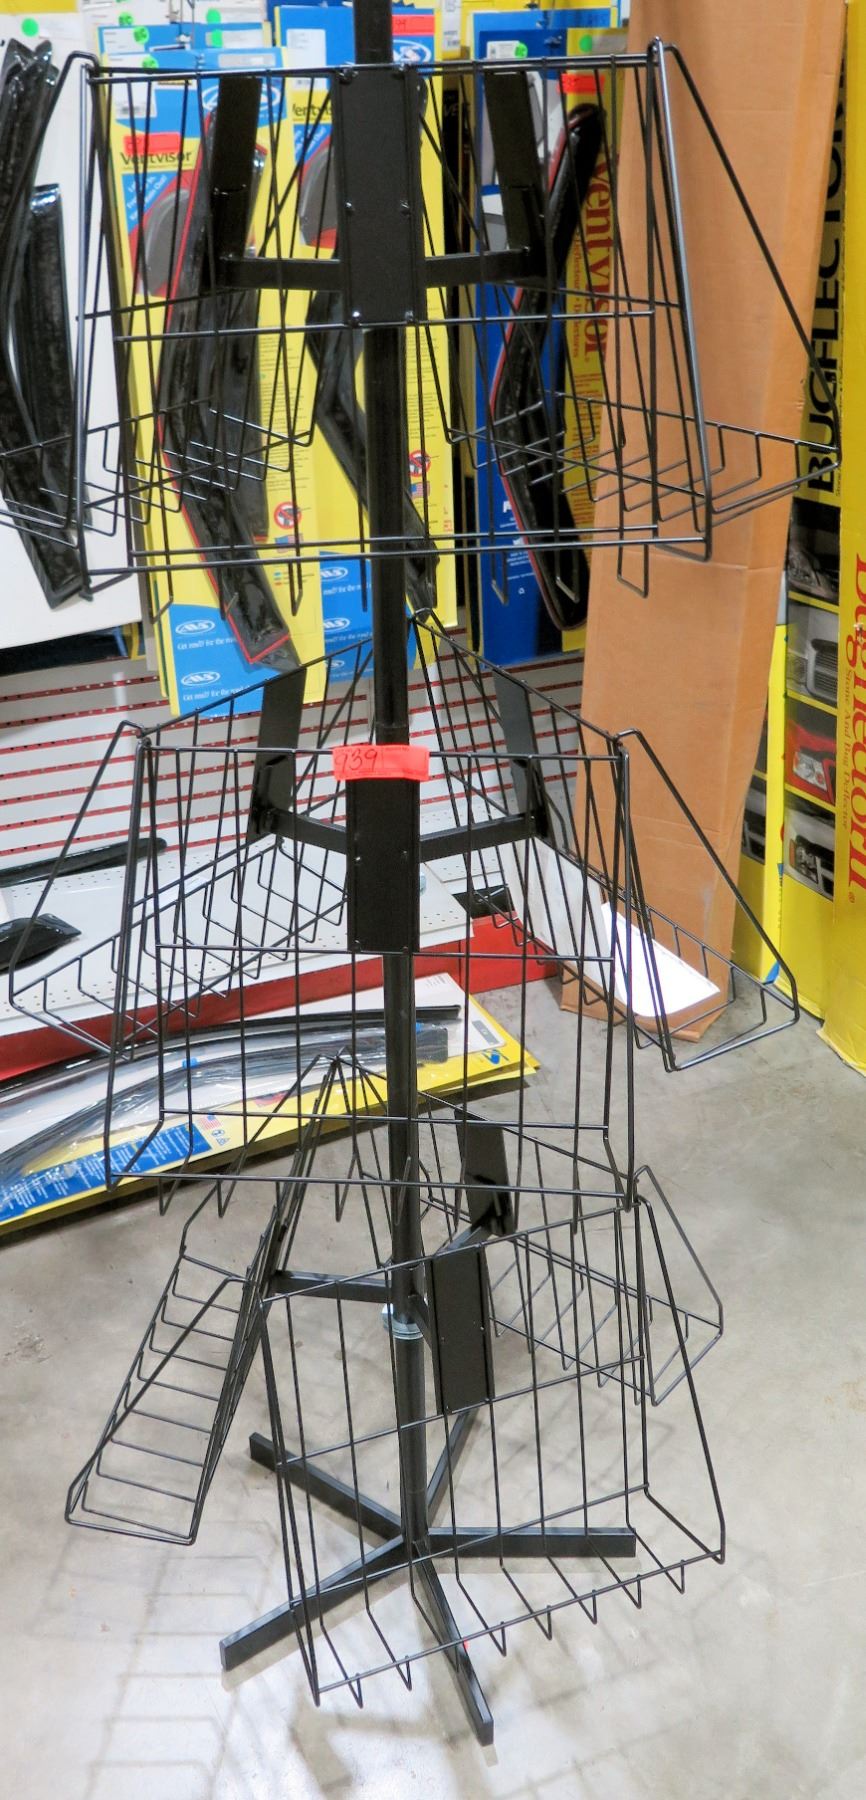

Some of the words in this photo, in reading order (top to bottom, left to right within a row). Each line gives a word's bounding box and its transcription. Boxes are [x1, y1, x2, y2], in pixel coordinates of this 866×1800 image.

[844, 669, 852, 703] Stone
[843, 710, 851, 738] And
[335, 748, 378, 773] 939
[843, 742, 851, 766] Bug
[842, 771, 850, 829] Deflector
